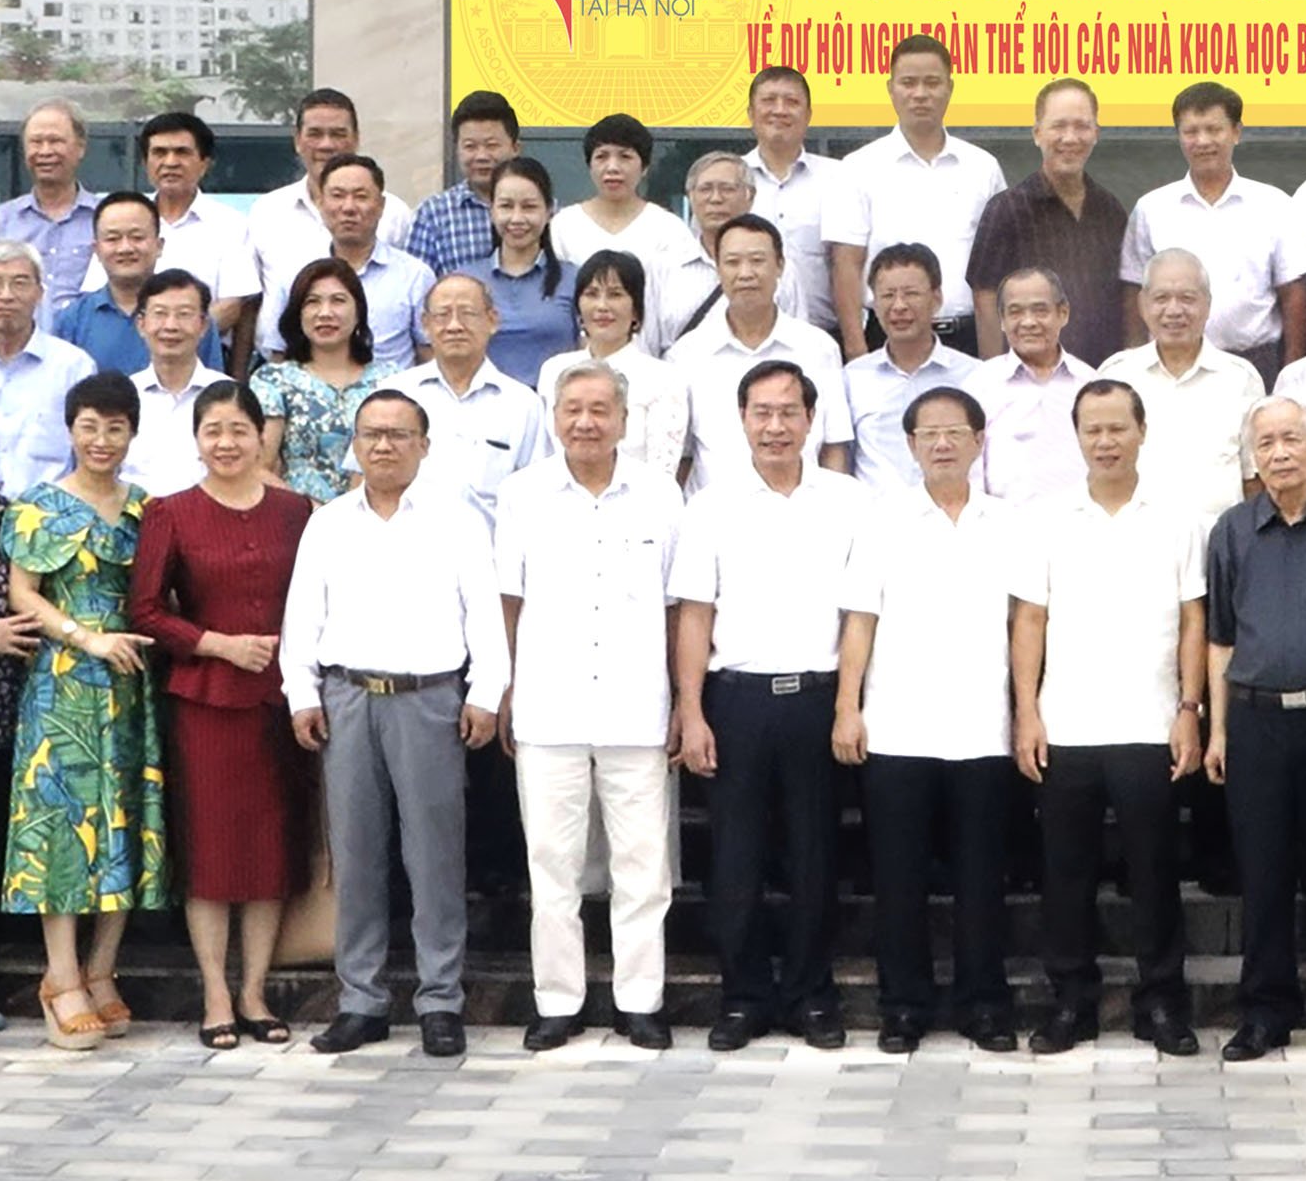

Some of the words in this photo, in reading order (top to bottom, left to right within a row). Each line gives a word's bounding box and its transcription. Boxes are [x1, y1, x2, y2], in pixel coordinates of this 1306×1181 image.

[475, 26, 543, 123] ASSOCIATION
[747, 3, 773, 74] VỀ
[817, 12, 853, 86] HỘI
[861, 23, 913, 75] NG
[985, 1, 1027, 74] THỂ
[1077, 12, 1120, 75] CÁC
[1128, 12, 1173, 74] NHÀ
[1180, 22, 1239, 75] KHOA
[1246, 22, 1289, 86] HỌC
